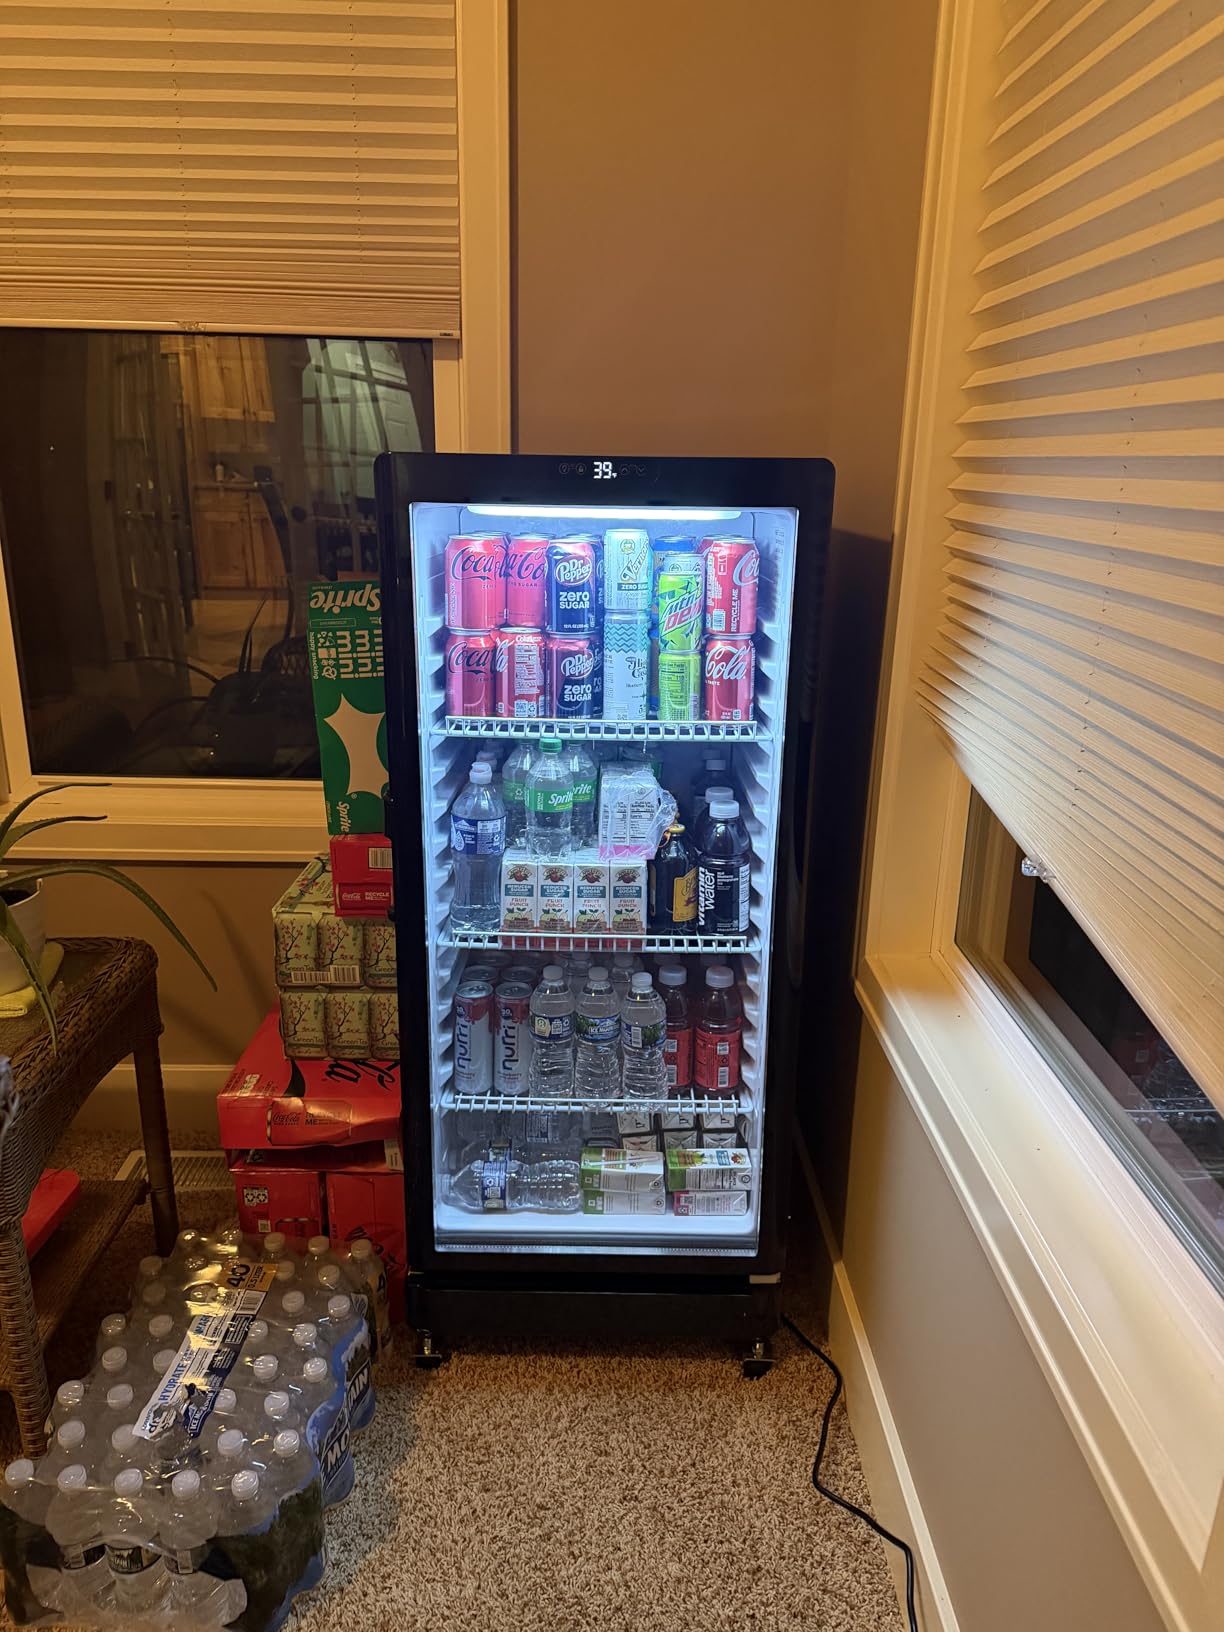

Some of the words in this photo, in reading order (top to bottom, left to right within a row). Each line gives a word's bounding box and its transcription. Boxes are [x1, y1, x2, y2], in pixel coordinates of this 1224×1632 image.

[559, 561, 591, 582] Pepper
[569, 558, 584, 570] Dr
[309, 583, 381, 614] Sprite
[559, 591, 590, 601] zero
[559, 601, 590, 609] SUGAR
[311, 652, 319, 679] snacking
[336, 630, 358, 679] mini
[355, 629, 376, 678] mini
[575, 654, 588, 664] Dr
[705, 645, 751, 681] Cola
[565, 657, 593, 677] Pepper
[564, 684, 592, 694] zero
[564, 694, 592, 702] SUGAR
[336, 801, 351, 832] Sprite
[705, 868, 715, 910] water
[457, 1022, 471, 1069] nurri
[502, 1025, 519, 1071] nurri
[226, 1264, 251, 1287] 40
